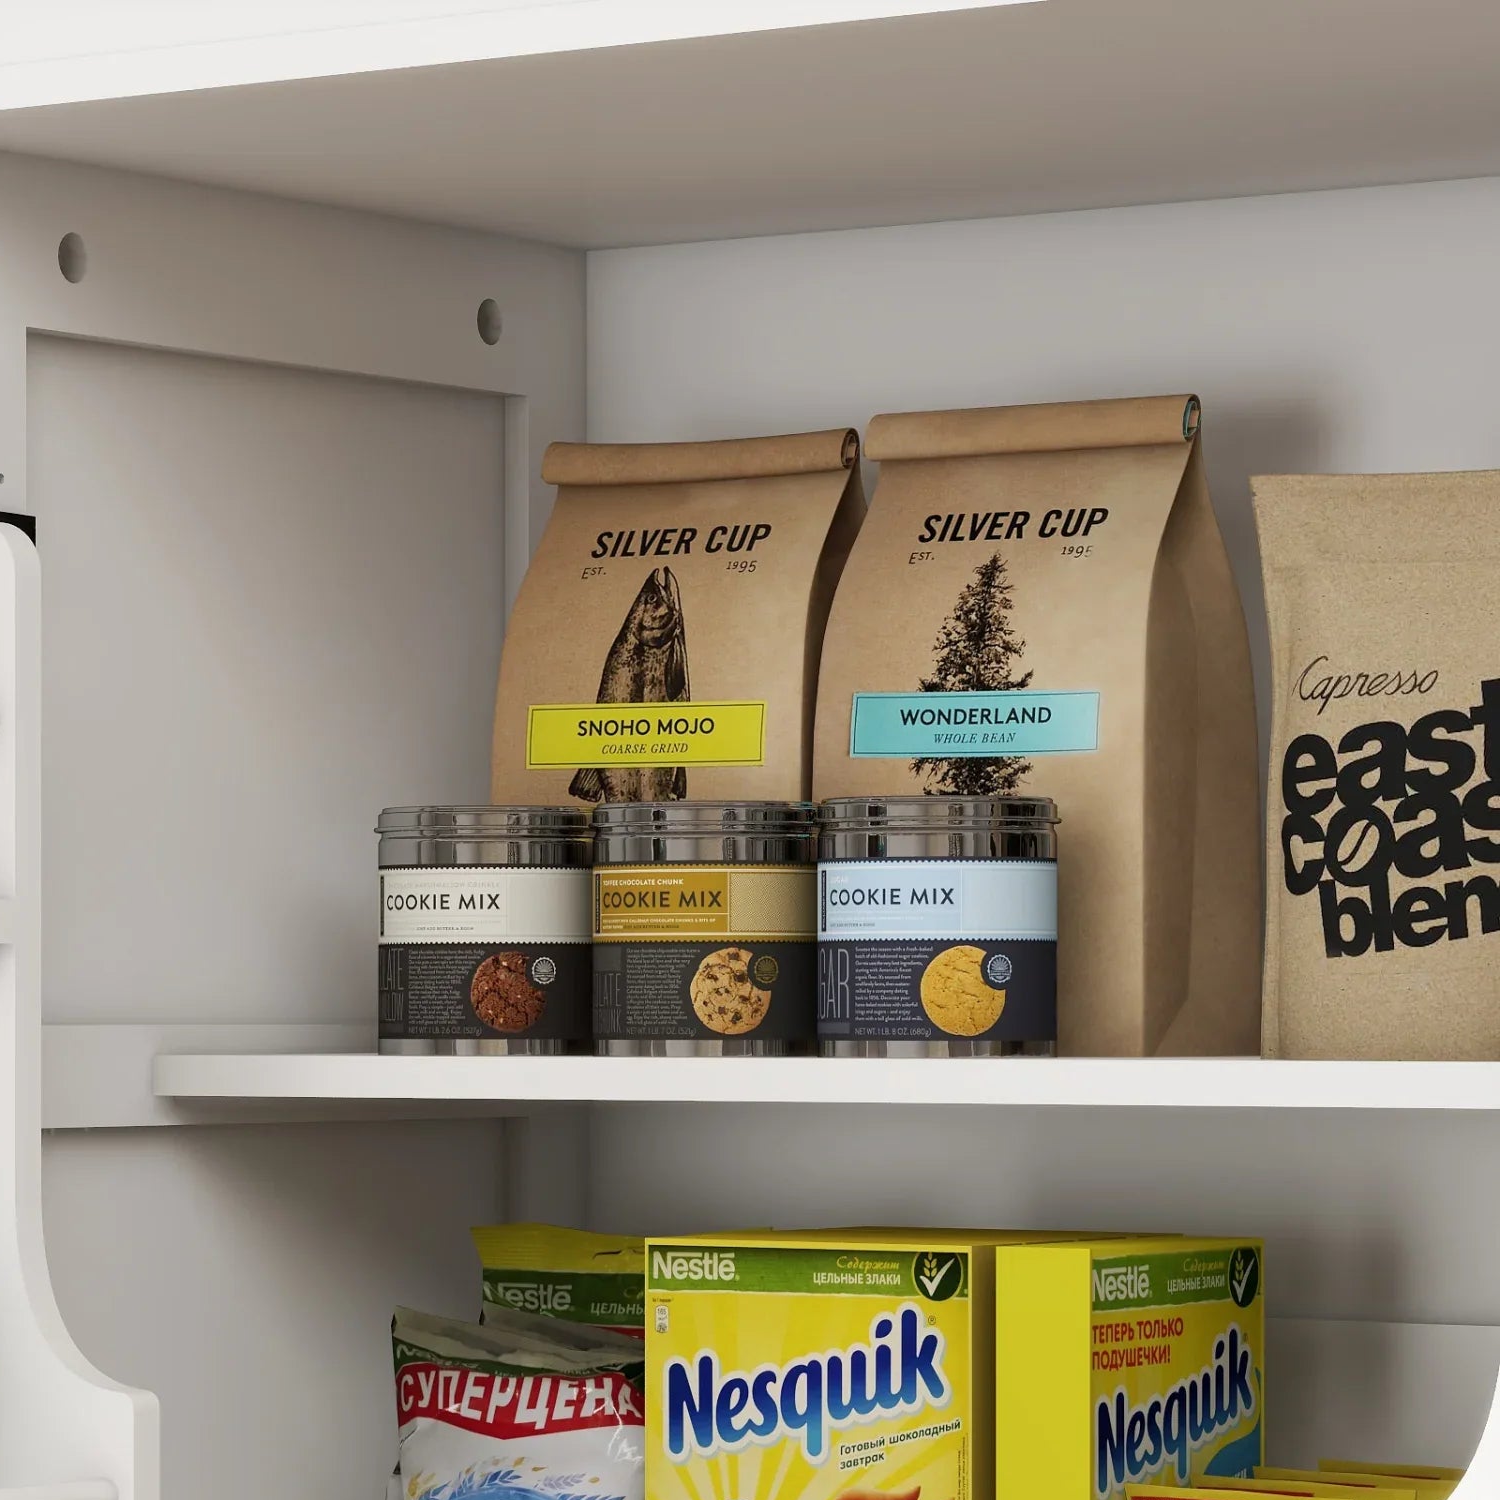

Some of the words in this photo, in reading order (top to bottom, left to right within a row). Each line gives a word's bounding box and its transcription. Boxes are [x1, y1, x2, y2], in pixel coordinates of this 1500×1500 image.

[918, 510, 1031, 543] SILVER
[1038, 507, 1109, 538] CUP
[591, 527, 698, 559] SILVER
[705, 523, 773, 553] CUP
[908, 551, 935, 565] EST.
[1061, 546, 1093, 559] 1995
[581, 564, 607, 580] EST.
[726, 559, 757, 574] 1995
[1292, 655, 1439, 716] Capresso
[577, 719, 652, 737] SNOHO
[657, 717, 715, 735] MOJO
[900, 707, 1053, 727] WONDERLAND
[933, 732, 978, 744] WHOLE
[981, 732, 1017, 743] BEAN
[1282, 677, 1500, 816] east
[601, 743, 648, 755] COARSE
[650, 742, 689, 754] GRIND
[619, 878, 656, 886] CHOCOLATE
[386, 893, 450, 911] COOKIE
[458, 893, 501, 910] MIX
[603, 891, 671, 909] COOKIE
[678, 890, 722, 908] MIX
[830, 888, 901, 906] COOKIE
[910, 888, 955, 905] MIX
[652, 1251, 736, 1282] Nestlé
[813, 1271, 864, 1286] ЦЕЛЬНЫЕ
[865, 1273, 901, 1286] ЗЛАКИ
[1092, 1264, 1150, 1302] Nestlé
[1167, 1277, 1201, 1293] ЦЕЛЬНЫЕ
[1202, 1276, 1225, 1290] ЗЛАКИ
[1092, 1322, 1134, 1345] ТЕПЕРЬ
[1136, 1317, 1184, 1339] ТОЛЬКО
[1092, 1344, 1171, 1372] ПОДУШЕЧКИ!
[666, 1307, 946, 1458] Nesquik
[399, 1369, 644, 1431] СУПЕРЦЕНА
[1097, 1327, 1252, 1494] Nesquik
[840, 1436, 886, 1456] Готовый
[888, 1419, 962, 1446] шоколадный
[840, 1452, 885, 1470] завтрак
